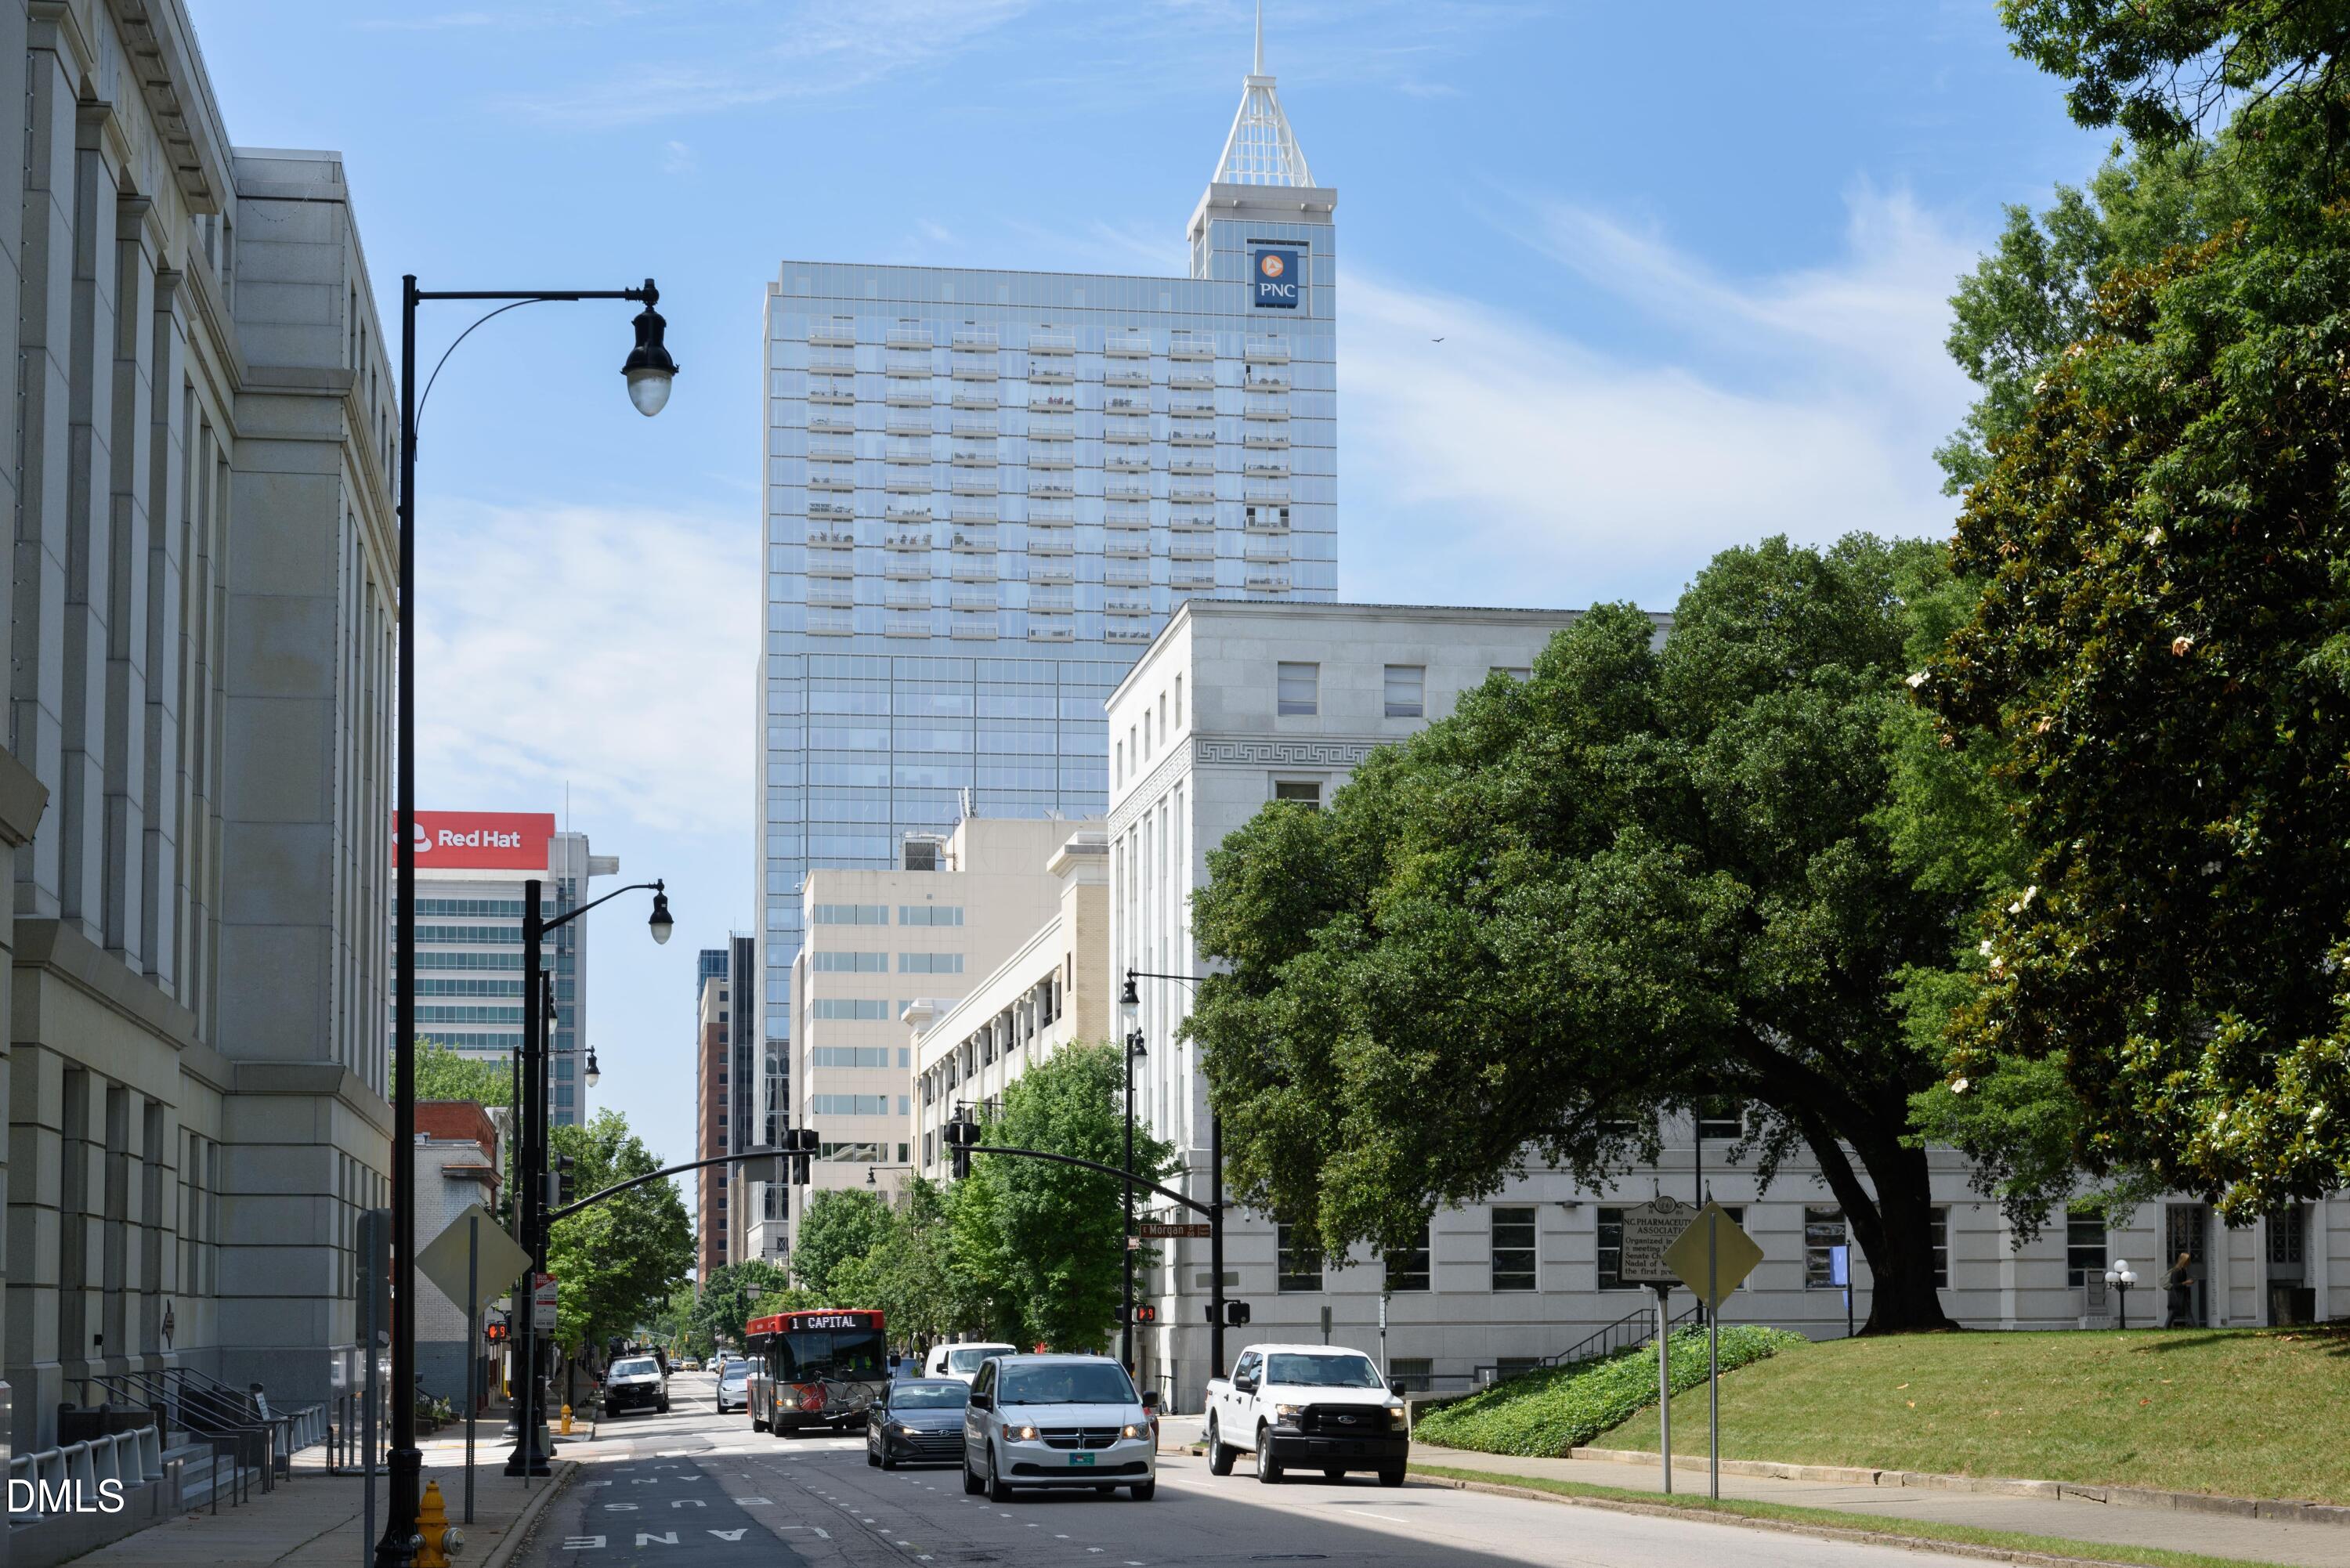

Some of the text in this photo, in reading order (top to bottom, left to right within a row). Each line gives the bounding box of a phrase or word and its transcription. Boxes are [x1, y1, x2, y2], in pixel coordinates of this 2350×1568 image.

[1259, 283, 1296, 298] PNC
[439, 830, 521, 847] Red Hat
[1149, 1225, 1184, 1237] Morgan
[1148, 1309, 1153, 1319] 9
[793, 1316, 856, 1329] 1 CAPITAL
[500, 1326, 505, 1337] 9
[604, 1497, 775, 1511] BUS
[562, 1526, 832, 1550] LANE
